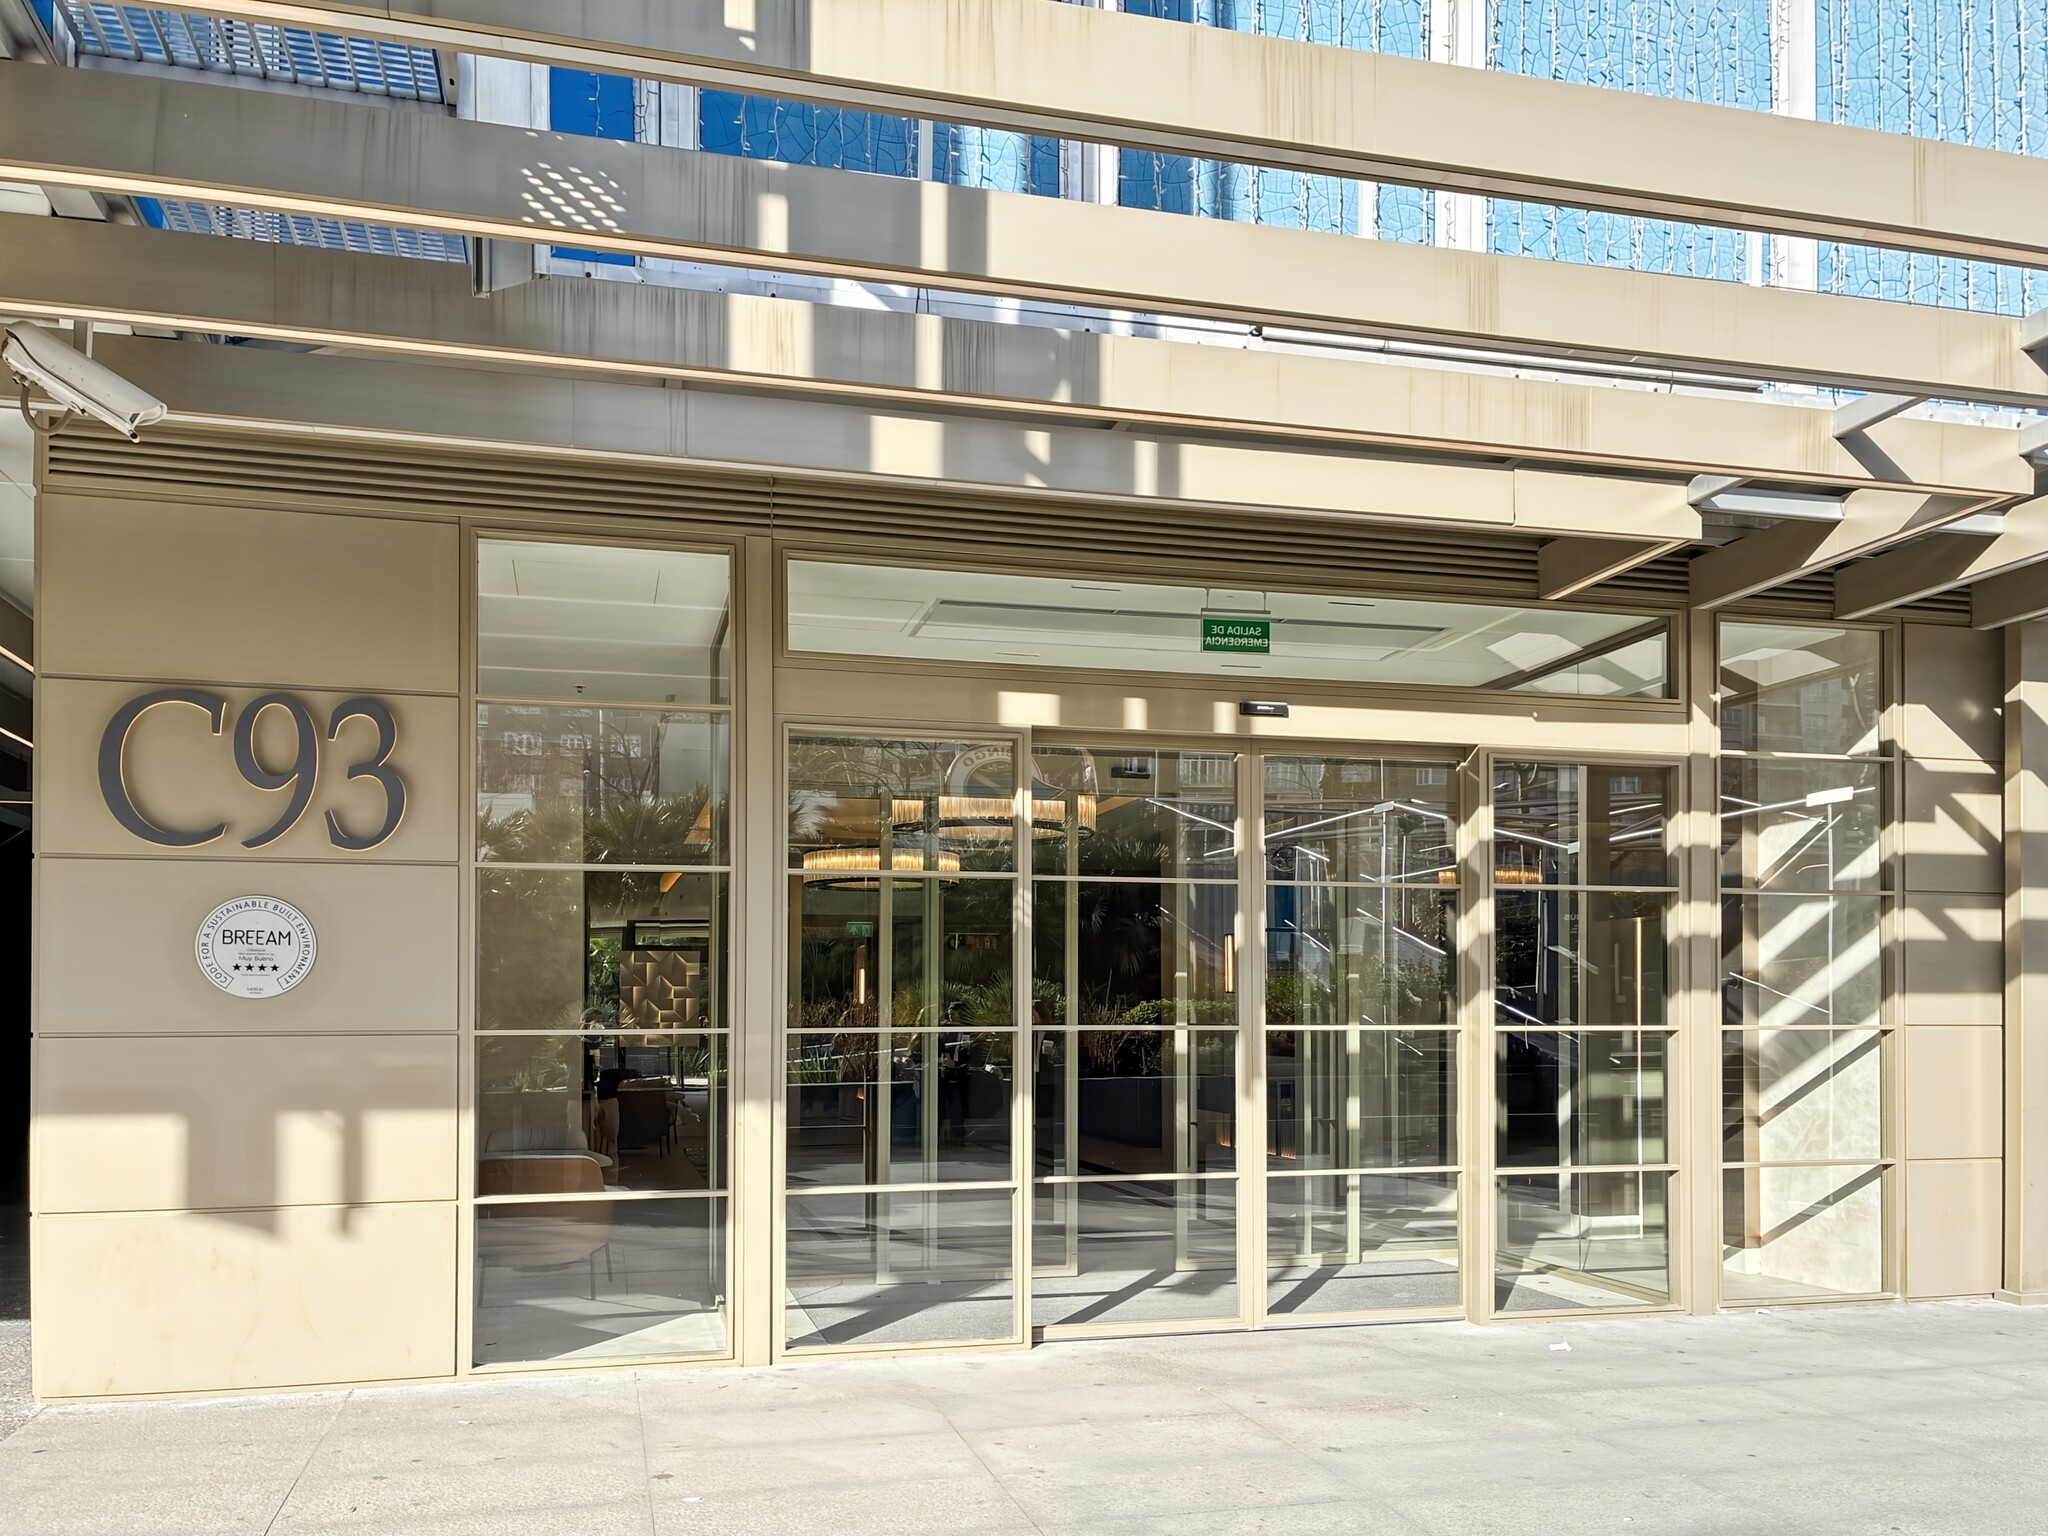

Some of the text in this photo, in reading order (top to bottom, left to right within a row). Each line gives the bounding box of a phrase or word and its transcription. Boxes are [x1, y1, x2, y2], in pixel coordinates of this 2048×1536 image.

[97, 687, 408, 852] C93
[207, 900, 270, 930] SUSTAINABLE
[272, 903, 299, 922] BUILT
[222, 929, 291, 946] BREEAM
[201, 942, 211, 960] FOR
[283, 922, 311, 985] ENVIRONMENT
[206, 962, 228, 984] CODE
